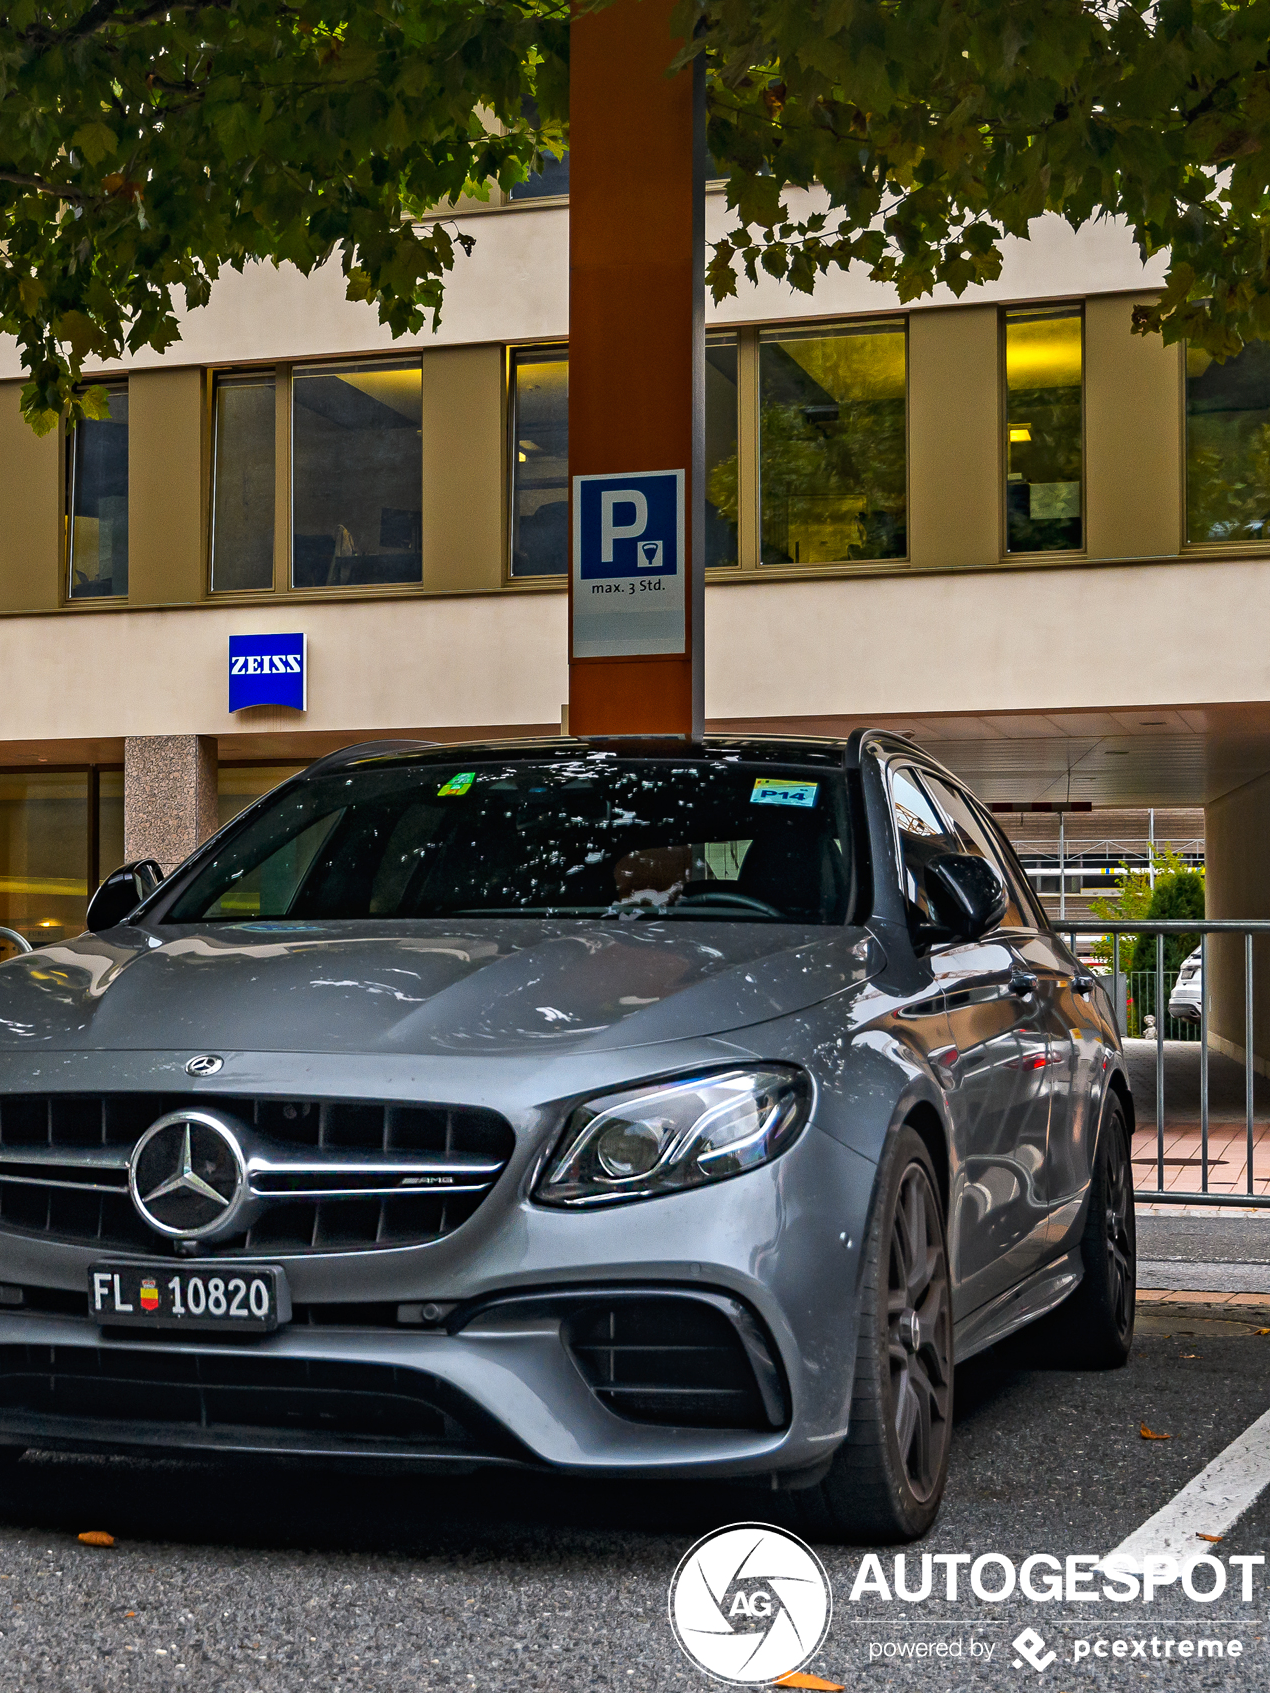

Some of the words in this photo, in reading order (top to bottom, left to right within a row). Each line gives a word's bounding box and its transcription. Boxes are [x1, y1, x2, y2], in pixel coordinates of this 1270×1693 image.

[601, 489, 648, 563] P
[592, 583, 625, 594] max.
[628, 583, 636, 595] 3
[639, 579, 666, 592] Std.
[231, 655, 301, 675] ZEISS
[760, 790, 806, 801] P14
[93, 1273, 133, 1312] FL
[168, 1276, 269, 1317] 10820
